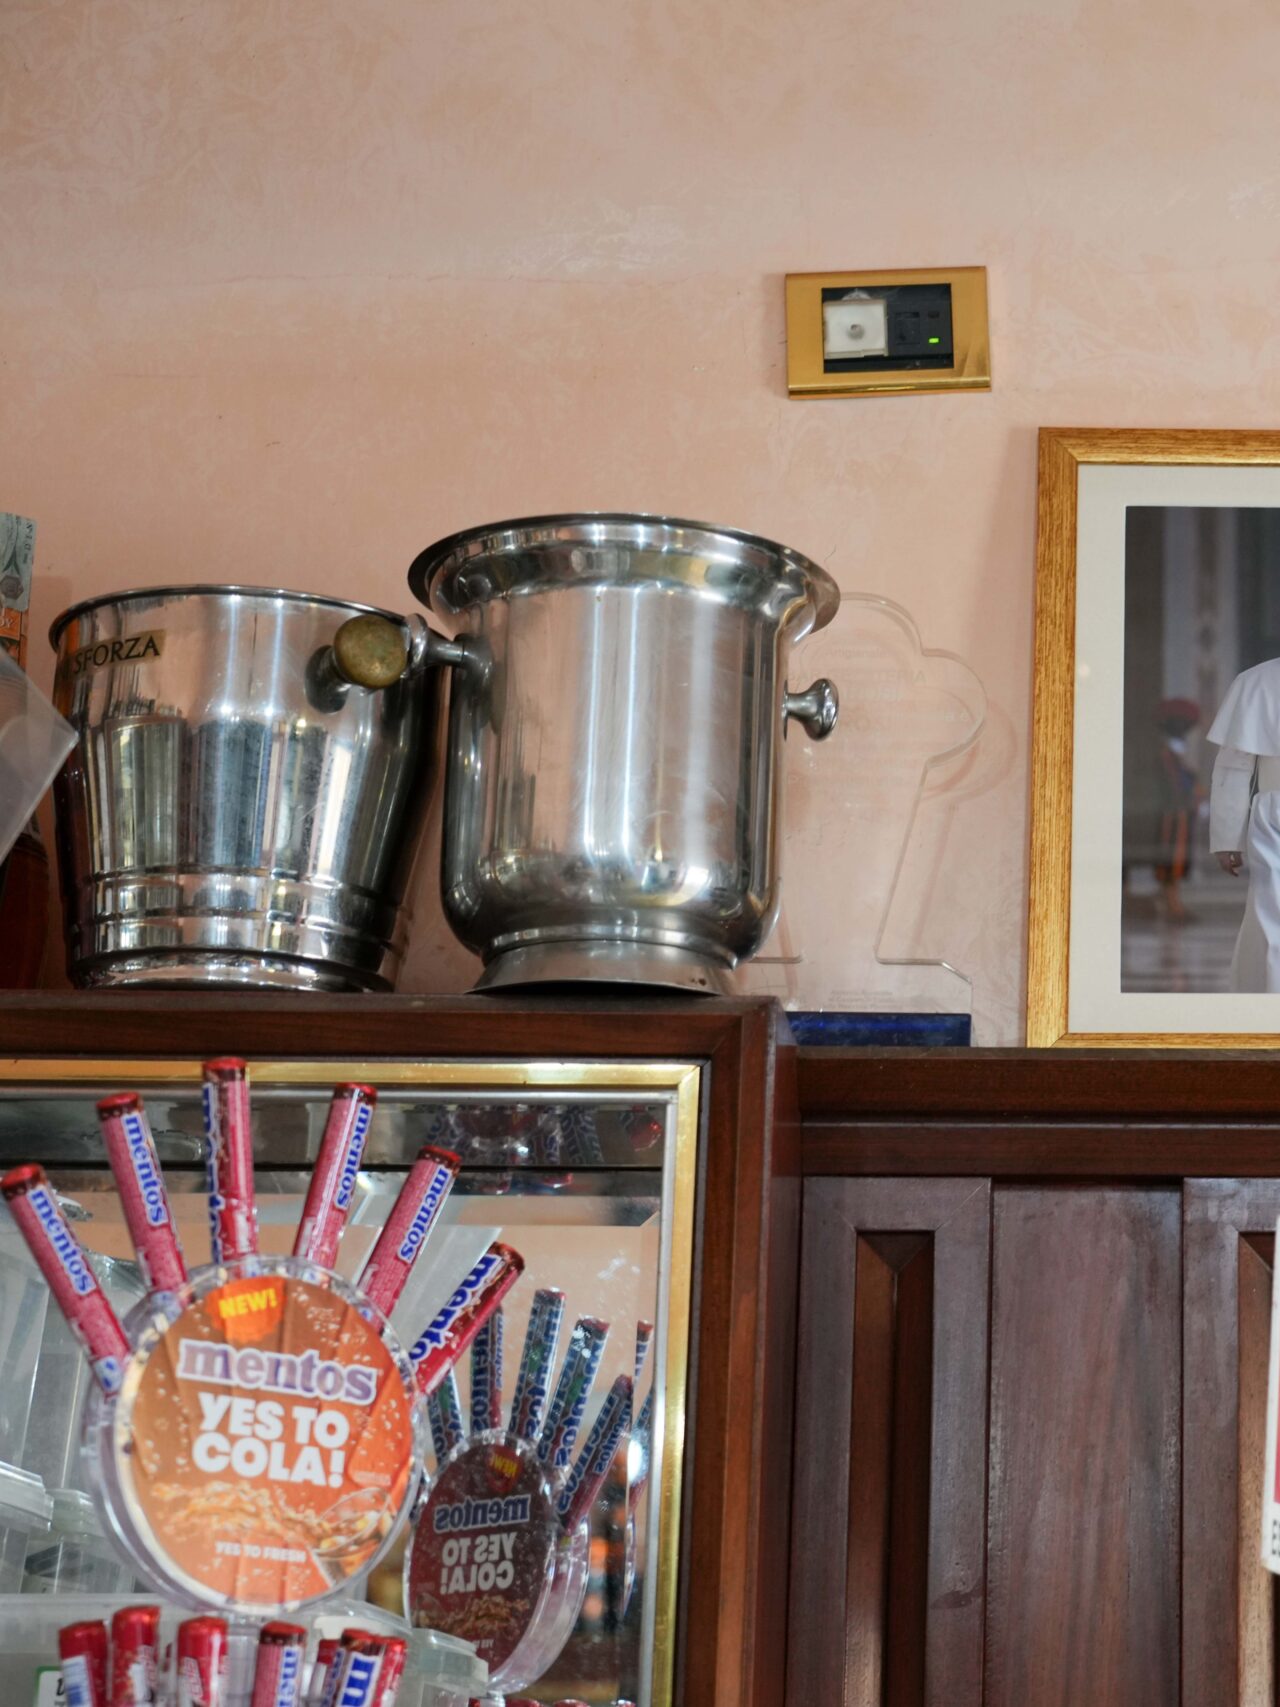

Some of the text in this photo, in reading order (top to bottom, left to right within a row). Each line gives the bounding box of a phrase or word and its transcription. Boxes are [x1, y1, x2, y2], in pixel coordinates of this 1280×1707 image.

[74, 634, 160, 674] SFORZA
[120, 1111, 169, 1227] mentos
[334, 1102, 373, 1211] mentos
[26, 1184, 97, 1296] mentos
[398, 1164, 452, 1266] mentos
[218, 1288, 278, 1319] NEW!
[406, 1253, 502, 1365] mento
[178, 1339, 376, 1405] mentos
[198, 1392, 350, 1449] YES TO
[192, 1432, 346, 1489] COLA!
[215, 1541, 306, 1563] YES TO FRESH
